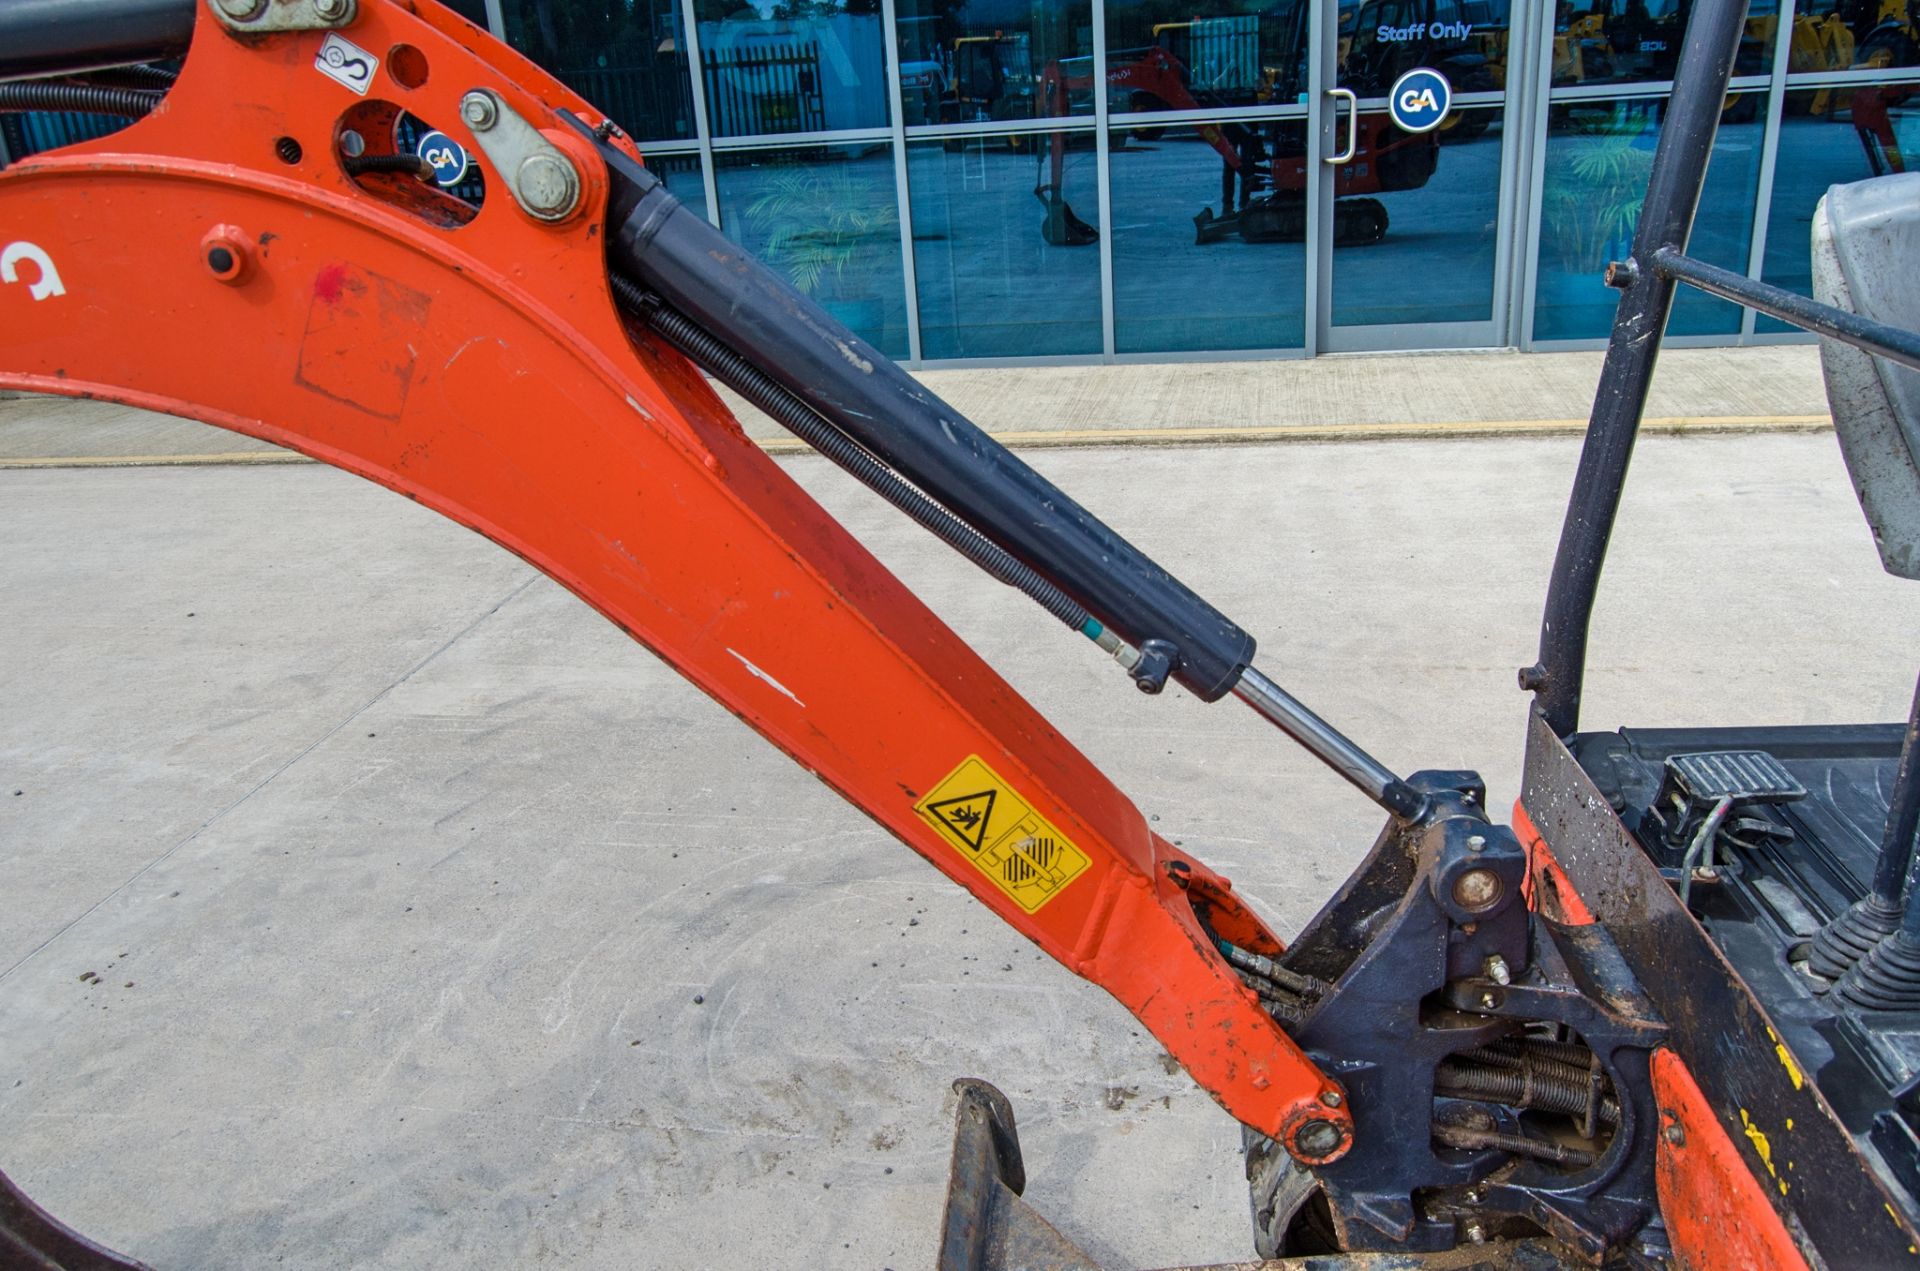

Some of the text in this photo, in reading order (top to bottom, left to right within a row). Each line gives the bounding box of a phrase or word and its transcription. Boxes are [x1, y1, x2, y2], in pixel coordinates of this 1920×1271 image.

[1376, 21, 1472, 42] Staff Only
[1400, 88, 1439, 113] GA
[426, 147, 459, 169] GA
